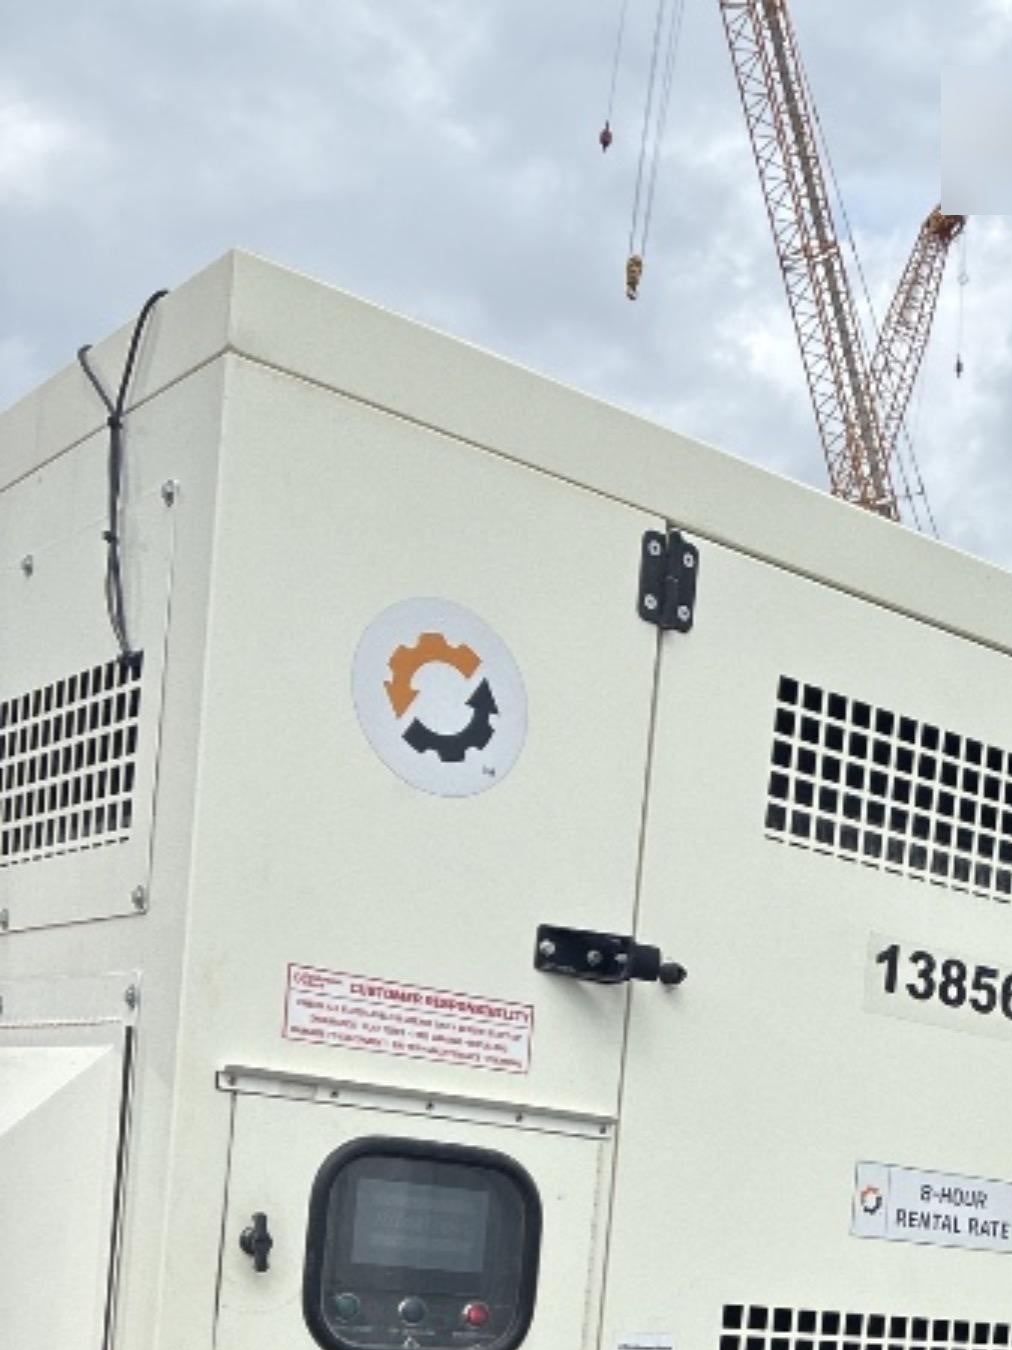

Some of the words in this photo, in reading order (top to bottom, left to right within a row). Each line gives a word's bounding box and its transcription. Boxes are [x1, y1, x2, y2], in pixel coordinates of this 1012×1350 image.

[349, 983, 423, 1005] CUSTOMER
[425, 995, 529, 1022] RESPONSIBILITY
[920, 1184, 988, 1209] 8-HOUR
[895, 1208, 961, 1234] RENTAL
[967, 1217, 1011, 1240] RATE
